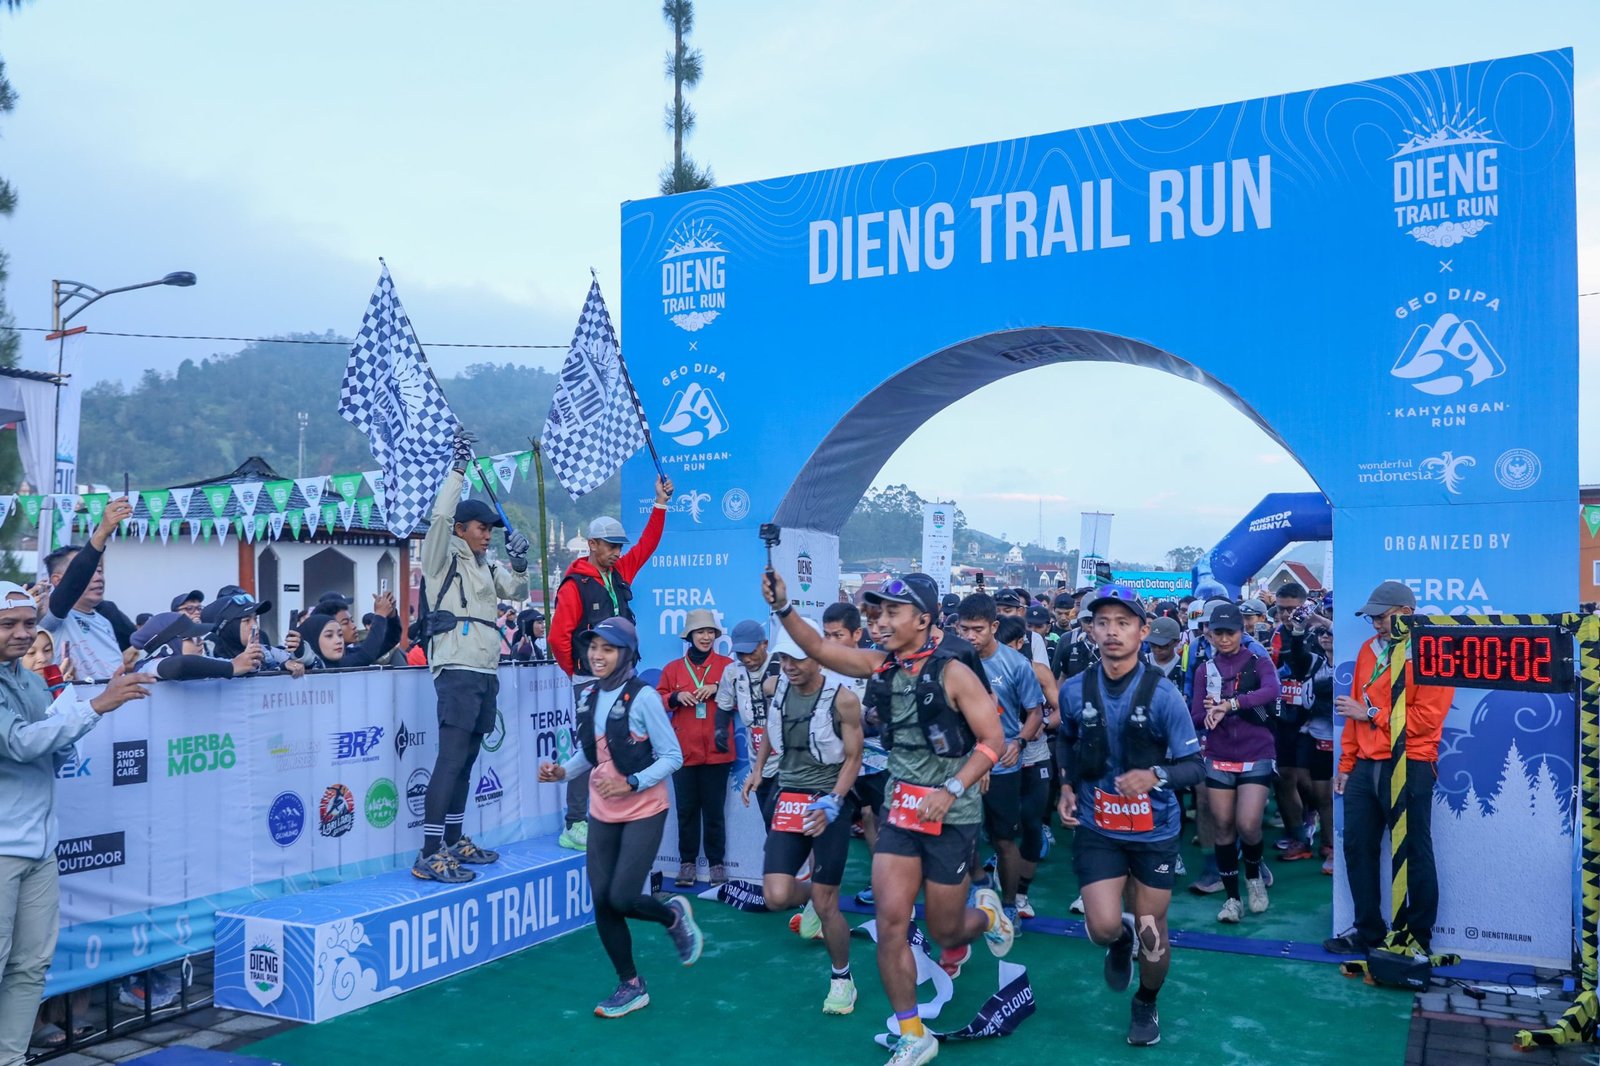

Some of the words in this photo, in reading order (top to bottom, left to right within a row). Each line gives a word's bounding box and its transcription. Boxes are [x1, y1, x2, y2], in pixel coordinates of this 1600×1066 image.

[1393, 148, 1498, 203] DIENG
[808, 202, 955, 285] DIENG
[971, 178, 1130, 264] TRAIL
[1149, 154, 1272, 243] RUN
[1394, 201, 1449, 228] TRAIL
[1457, 195, 1498, 217] RUN
[662, 255, 726, 296] DIENG
[662, 296, 696, 315] TRAIL
[700, 292, 726, 309] RUN
[1395, 291, 1438, 319] GEO
[1448, 288, 1501, 312] DIPA
[662, 365, 689, 386] GEO
[694, 363, 726, 382] DIPA
[1394, 402, 1505, 418] KAHYANGAN
[1431, 416, 1466, 428] RUN
[661, 452, 729, 463] KAHYANGAN
[1358, 459, 1412, 471] wonderful
[683, 462, 706, 471] RUN
[1358, 467, 1434, 483] indonesia
[1249, 520, 1292, 532] PLUSNYA
[1250, 511, 1292, 526] NONSTOP
[1384, 534, 1483, 551] ORGANIZED
[1489, 533, 1511, 549] BY
[652, 553, 713, 568] ORGANIZED
[715, 553, 729, 565] BY
[1081, 558, 1105, 570] DIEN
[1114, 578, 1144, 589] elamat
[1145, 579, 1175, 592] Datang
[1175, 578, 1184, 589] di
[652, 587, 716, 606] TERRA
[1419, 635, 1552, 682] 06:00:02
[262, 689, 335, 710] AFFILIATION
[530, 708, 572, 730] TERRA
[167, 733, 235, 756] HERBA
[116, 749, 145, 760] SHOES
[116, 758, 136, 768] AND
[167, 750, 237, 777] MOJO
[116, 766, 139, 777] CARE
[778, 800, 812, 815] 2037
[1102, 801, 1151, 816] 20408
[57, 839, 93, 856] MAIN
[57, 850, 123, 872] OUTDOOR
[388, 898, 480, 981] DIENG
[486, 871, 560, 945] TRAIL
[566, 866, 594, 919] RU
[1481, 930, 1533, 943] DIENGTRAILRUN
[250, 953, 279, 974] DIENG
[250, 971, 266, 980] TRAIL
